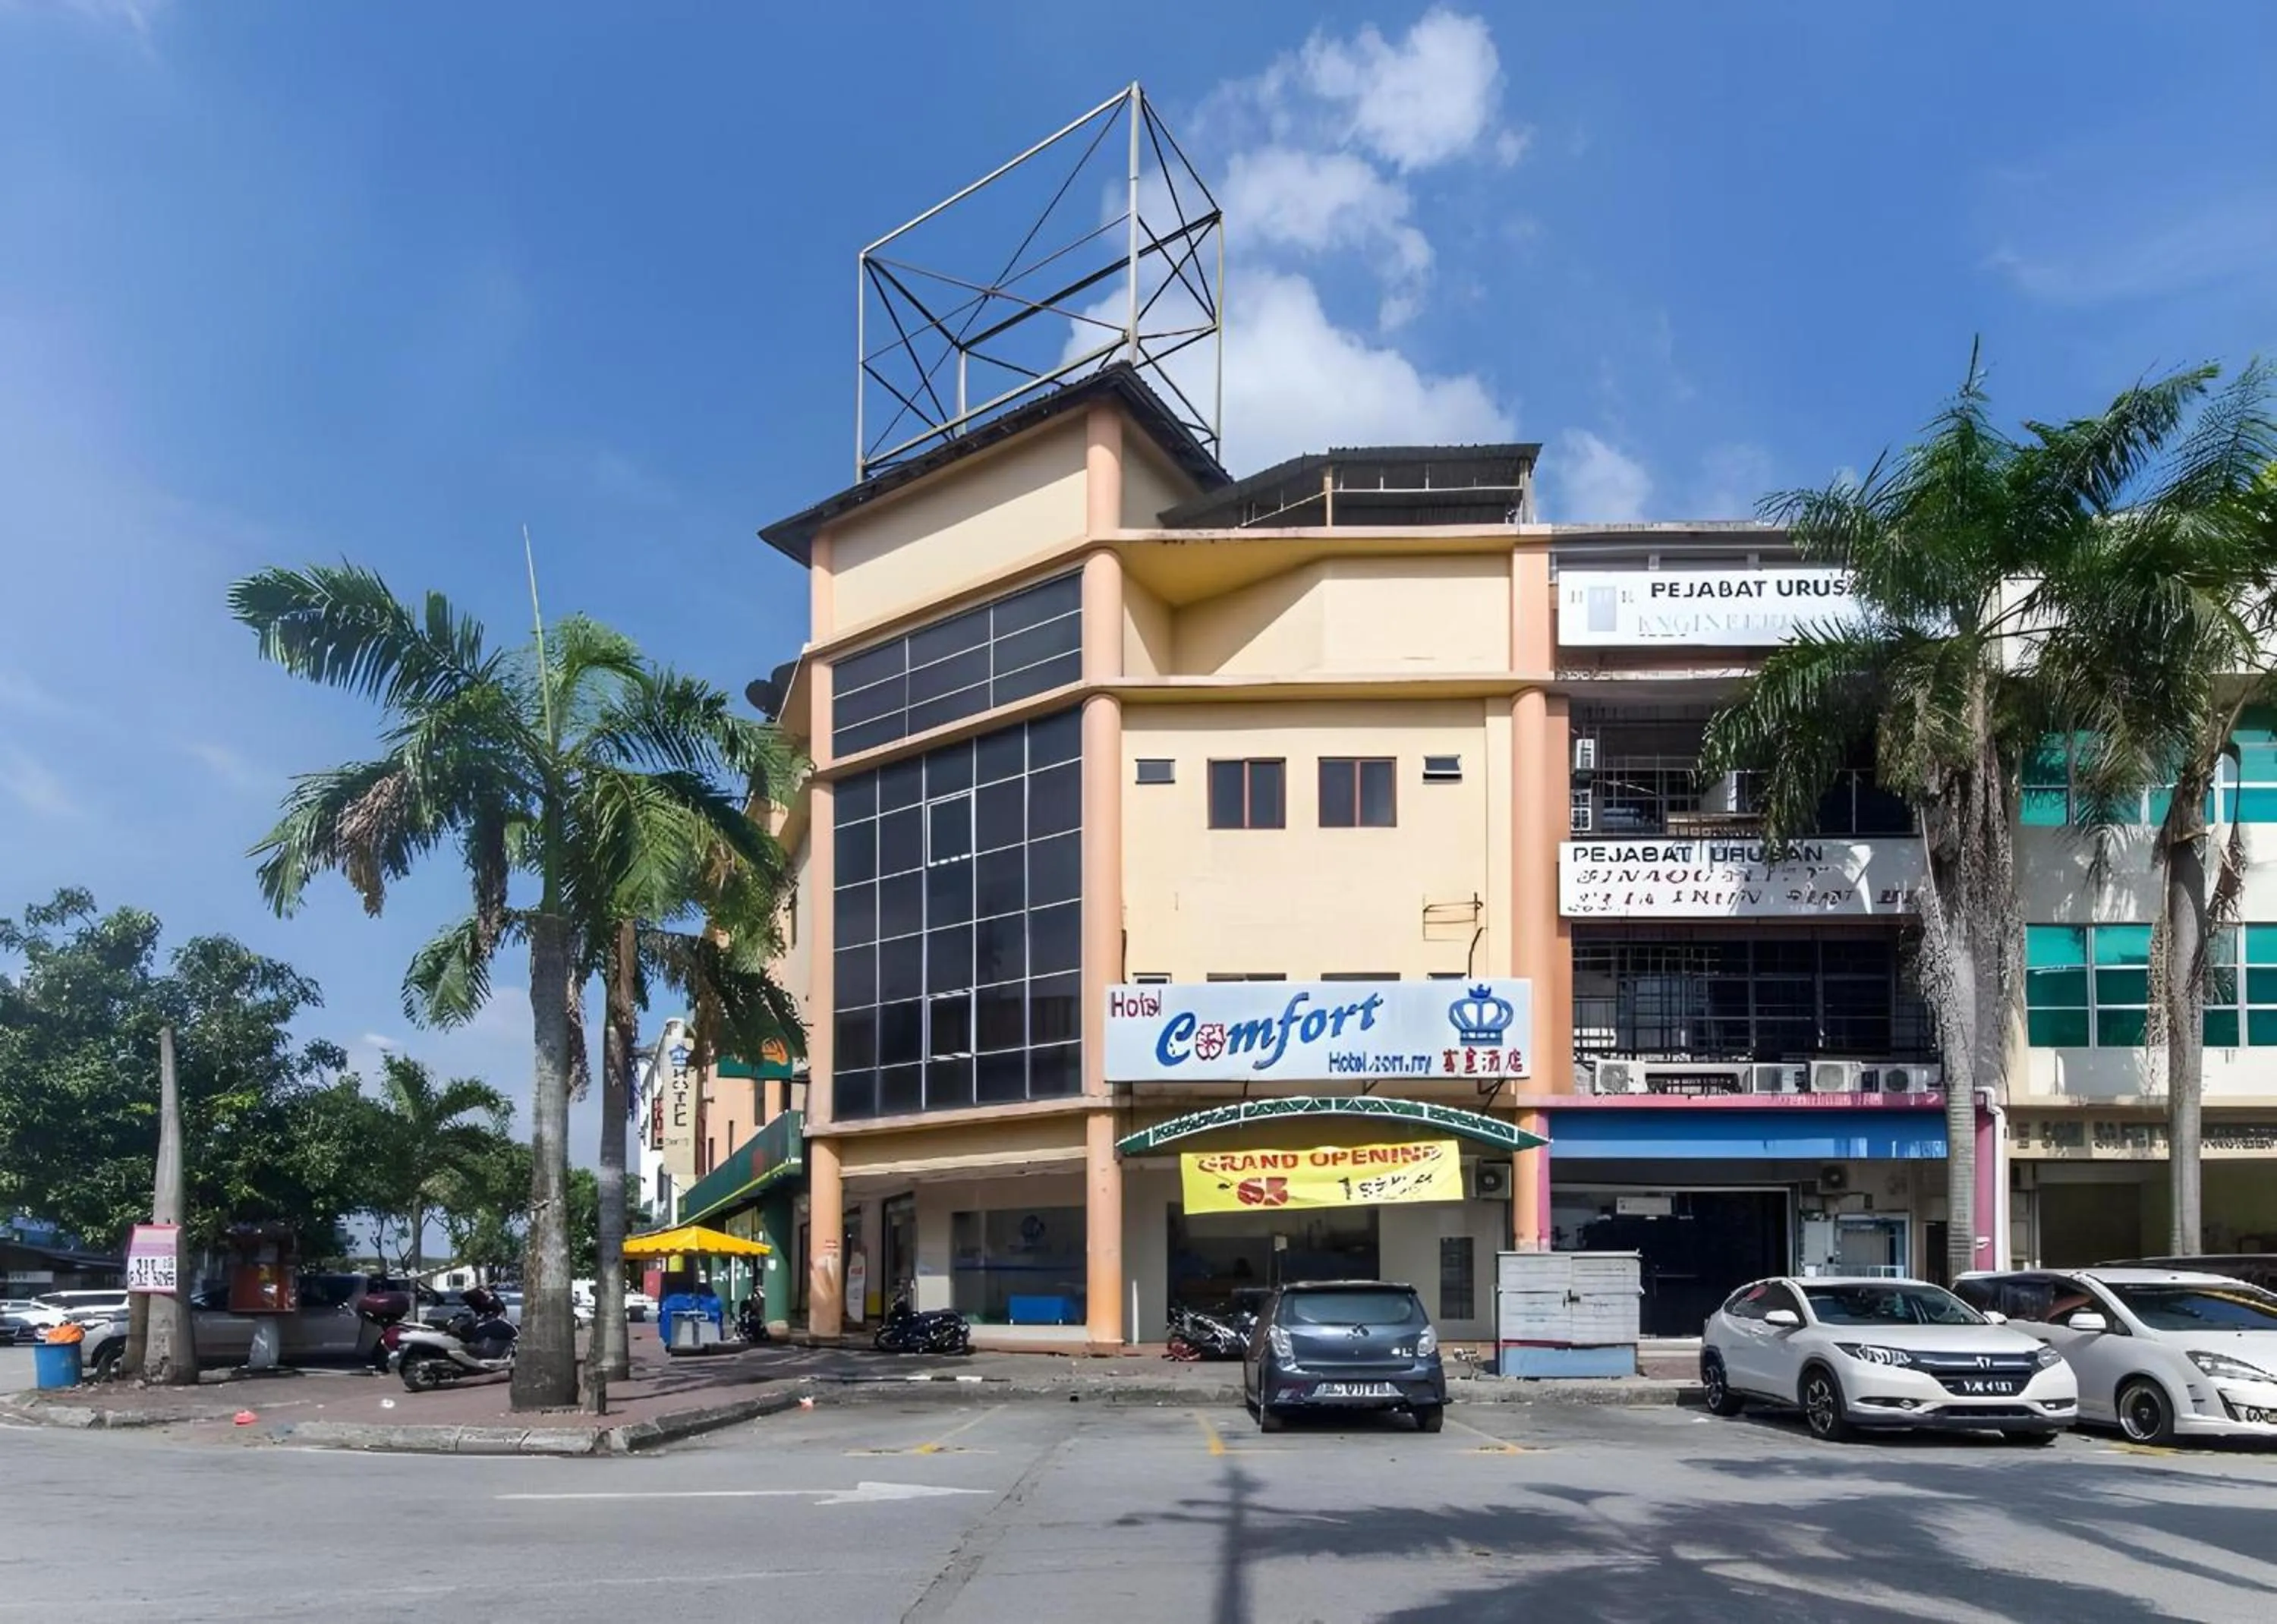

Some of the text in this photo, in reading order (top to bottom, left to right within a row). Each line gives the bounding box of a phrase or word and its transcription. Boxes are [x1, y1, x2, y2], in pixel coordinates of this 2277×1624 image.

[1650, 578, 1857, 599] PEJABAT URUS
[1573, 845, 1693, 864] PEJABAT
[1197, 1144, 1442, 1172] GRAND OPENING
